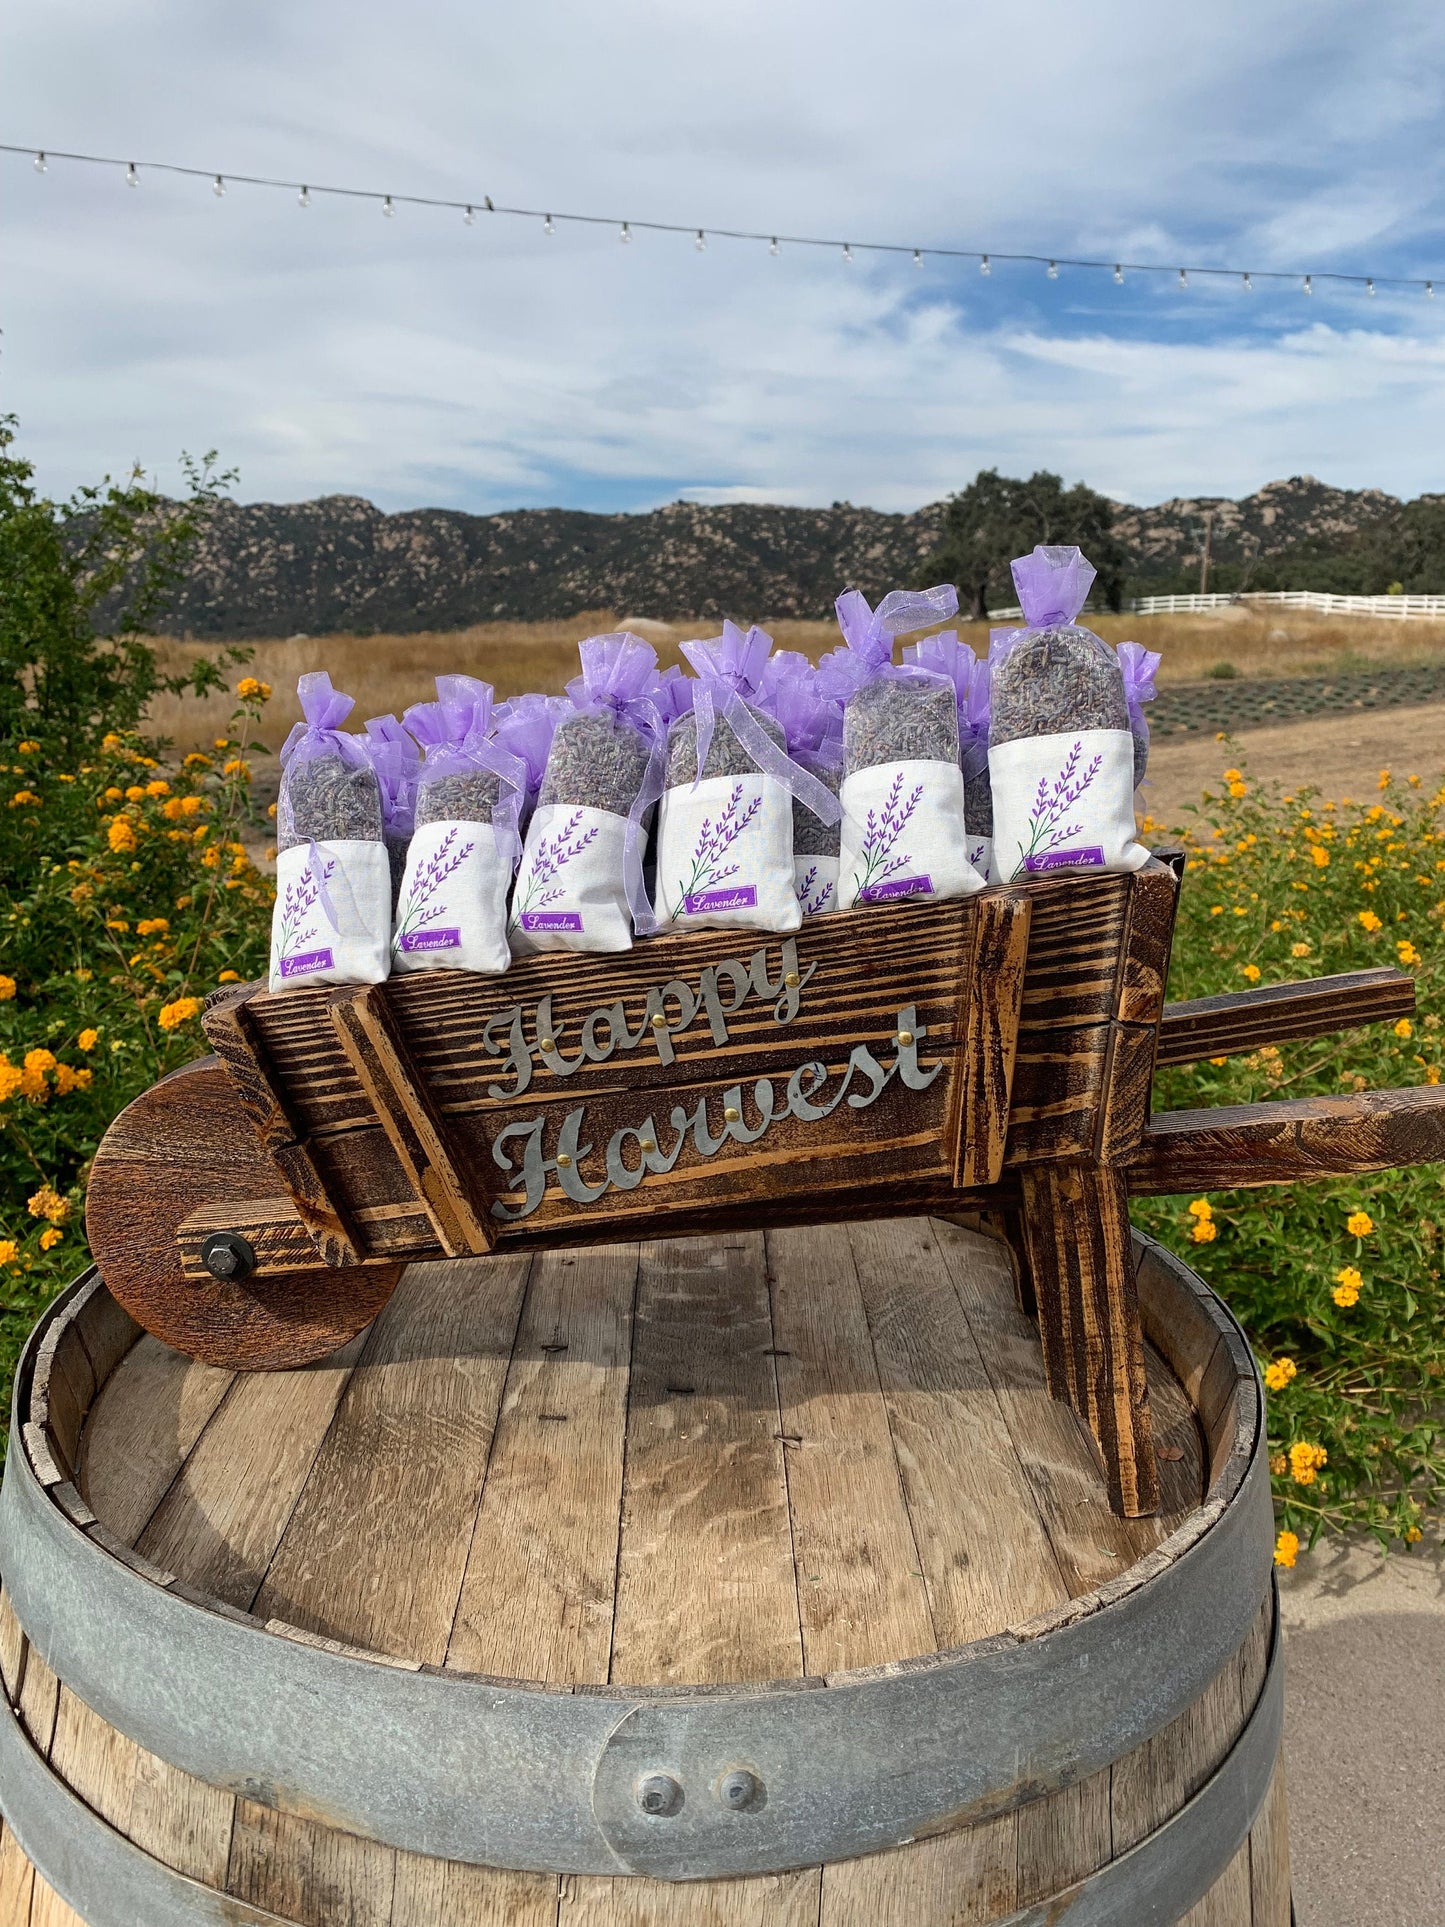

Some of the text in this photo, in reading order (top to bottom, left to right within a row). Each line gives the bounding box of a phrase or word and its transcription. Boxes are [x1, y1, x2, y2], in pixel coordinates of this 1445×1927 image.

[1033, 853, 1096, 871] Lavender
[869, 882, 925, 900] Lavender
[692, 892, 749, 912] Lavender
[527, 915, 576, 930] Lavender
[406, 933, 455, 950] Lavender
[284, 955, 327, 976] Lavender
[482, 937, 818, 1100] Happy
[490, 1003, 944, 1220] Harvest
